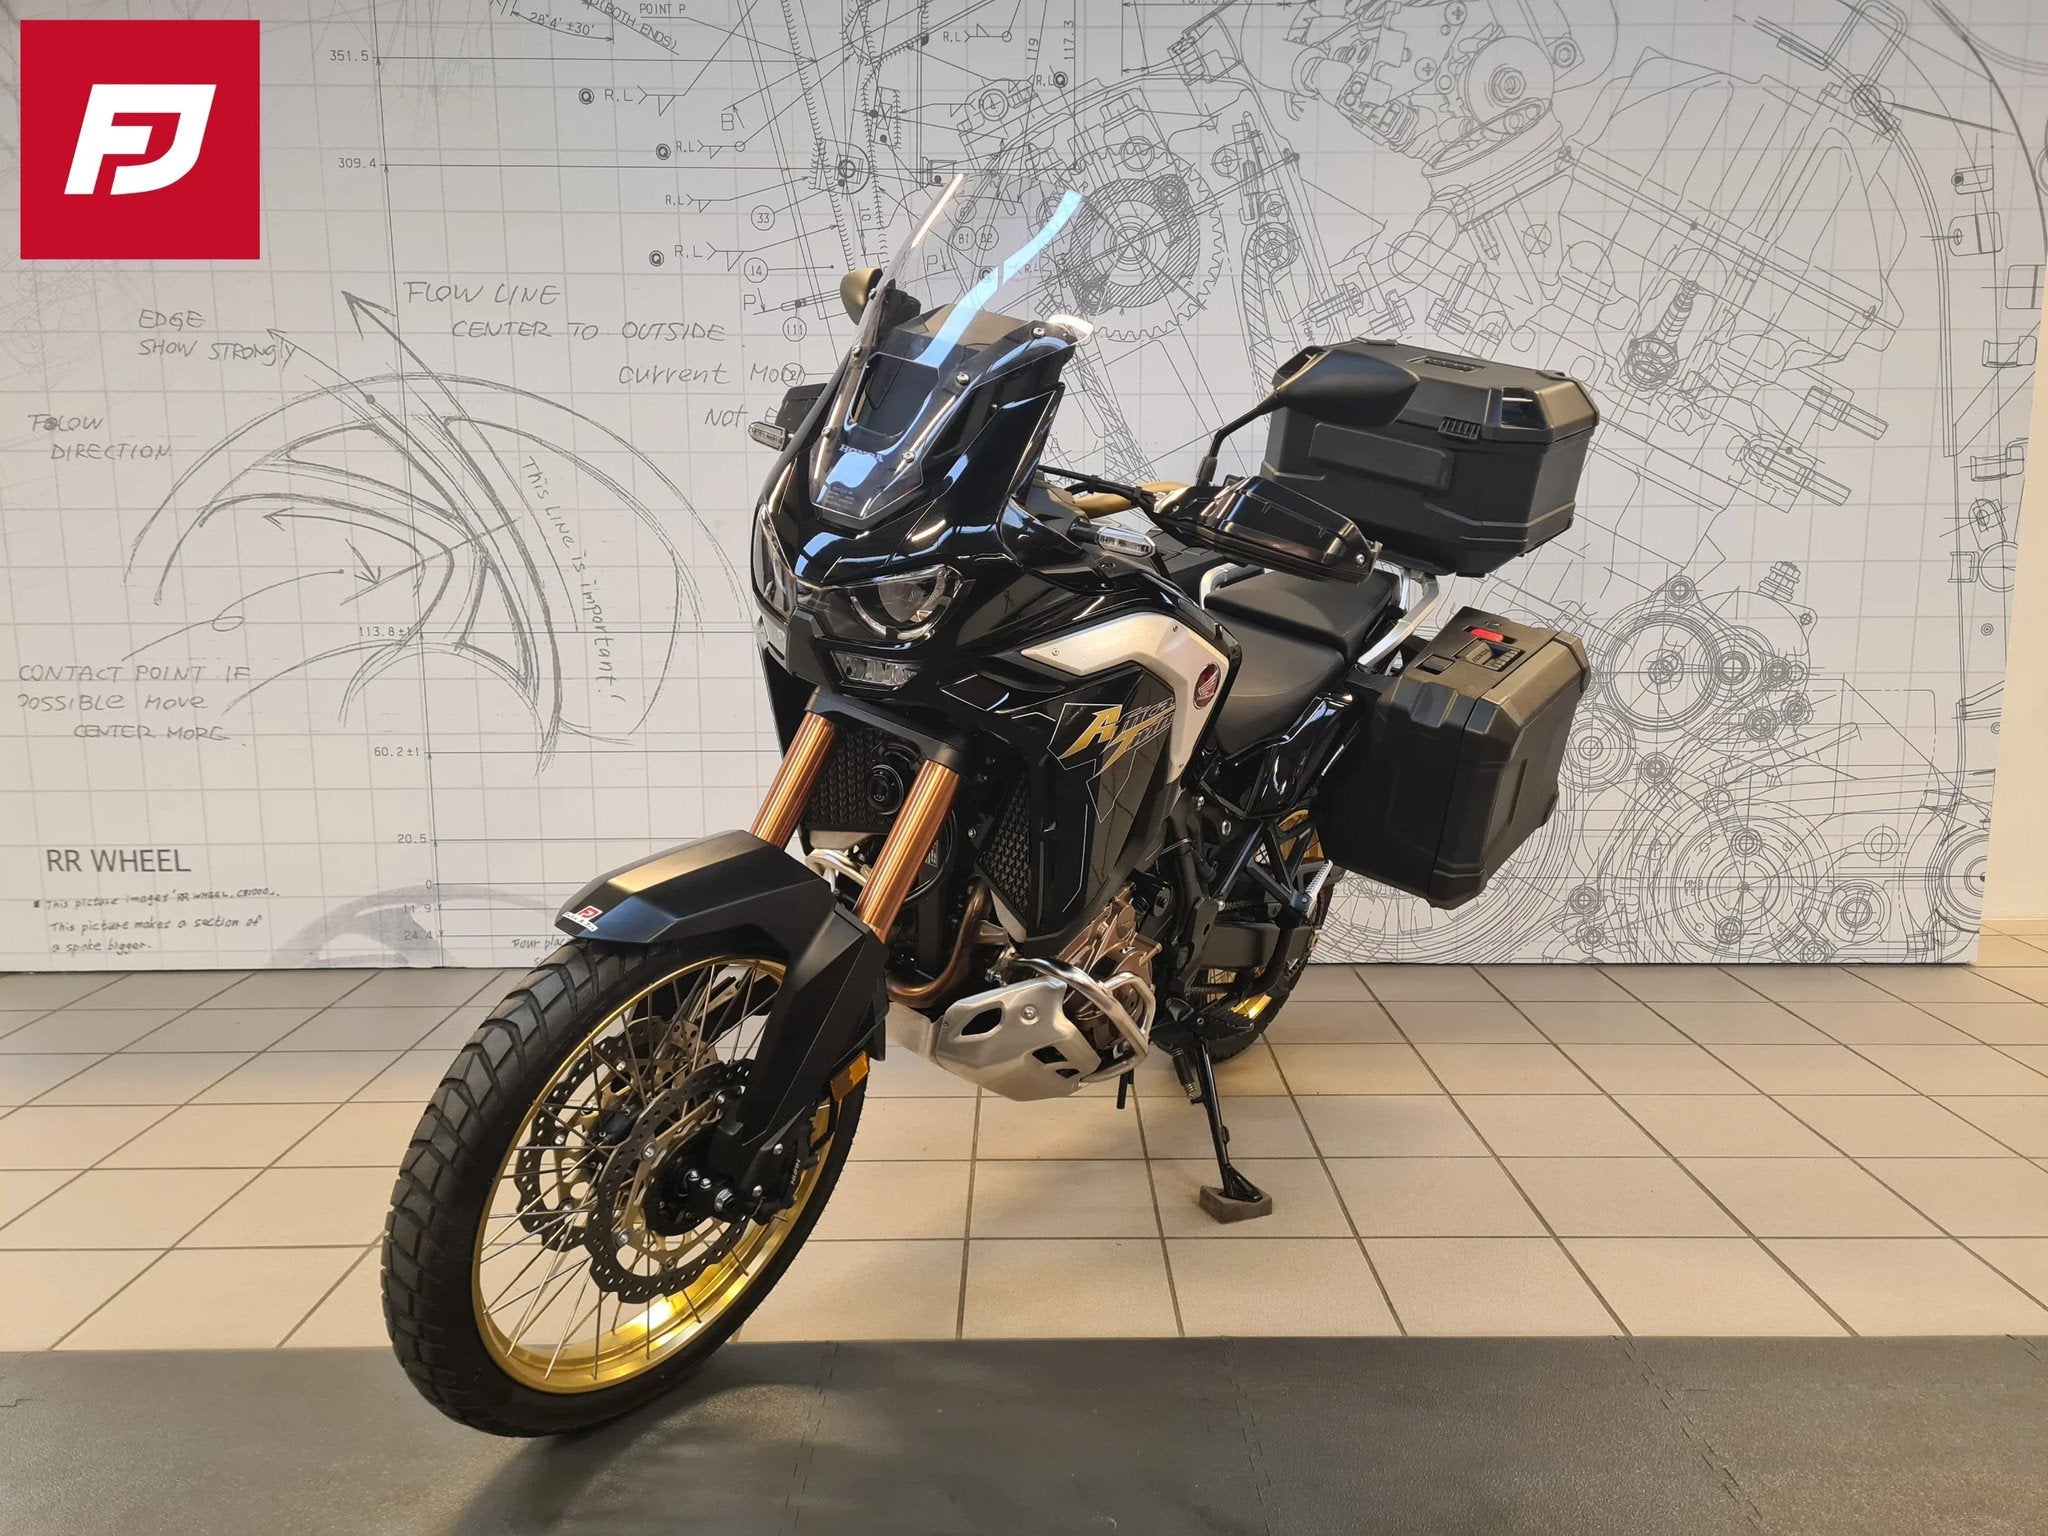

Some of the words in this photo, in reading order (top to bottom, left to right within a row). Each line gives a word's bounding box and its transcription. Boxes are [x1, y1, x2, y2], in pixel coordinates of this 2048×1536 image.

[639, 3, 671, 15] POINT
[679, 3, 686, 15] P
[640, 22, 677, 50] ENDS)
[1063, 20, 1074, 60] 117.3
[329, 49, 369, 61] 351.5
[721, 112, 735, 131] B
[338, 157, 376, 169] 309.4
[756, 213, 770, 223] 33
[751, 265, 763, 276] 14
[403, 281, 484, 303] FLOW
[494, 282, 561, 305] LINE
[743, 294, 757, 311] P
[139, 308, 206, 331] EDGE
[452, 319, 553, 338] CENTER
[567, 322, 599, 341] TO
[621, 321, 725, 342] OUTSIDE
[138, 338, 198, 357] SHOW
[618, 362, 731, 385] Current
[50, 443, 172, 461] DIRECTION
[18, 664, 124, 682] CONTACT
[136, 664, 207, 682] POINT
[226, 665, 251, 683] IF
[74, 724, 156, 740] CENTER
[397, 833, 427, 844] 20.5
[46, 848, 83, 872] RR
[90, 848, 192, 872] WHEEL
[425, 879, 433, 890] 0
